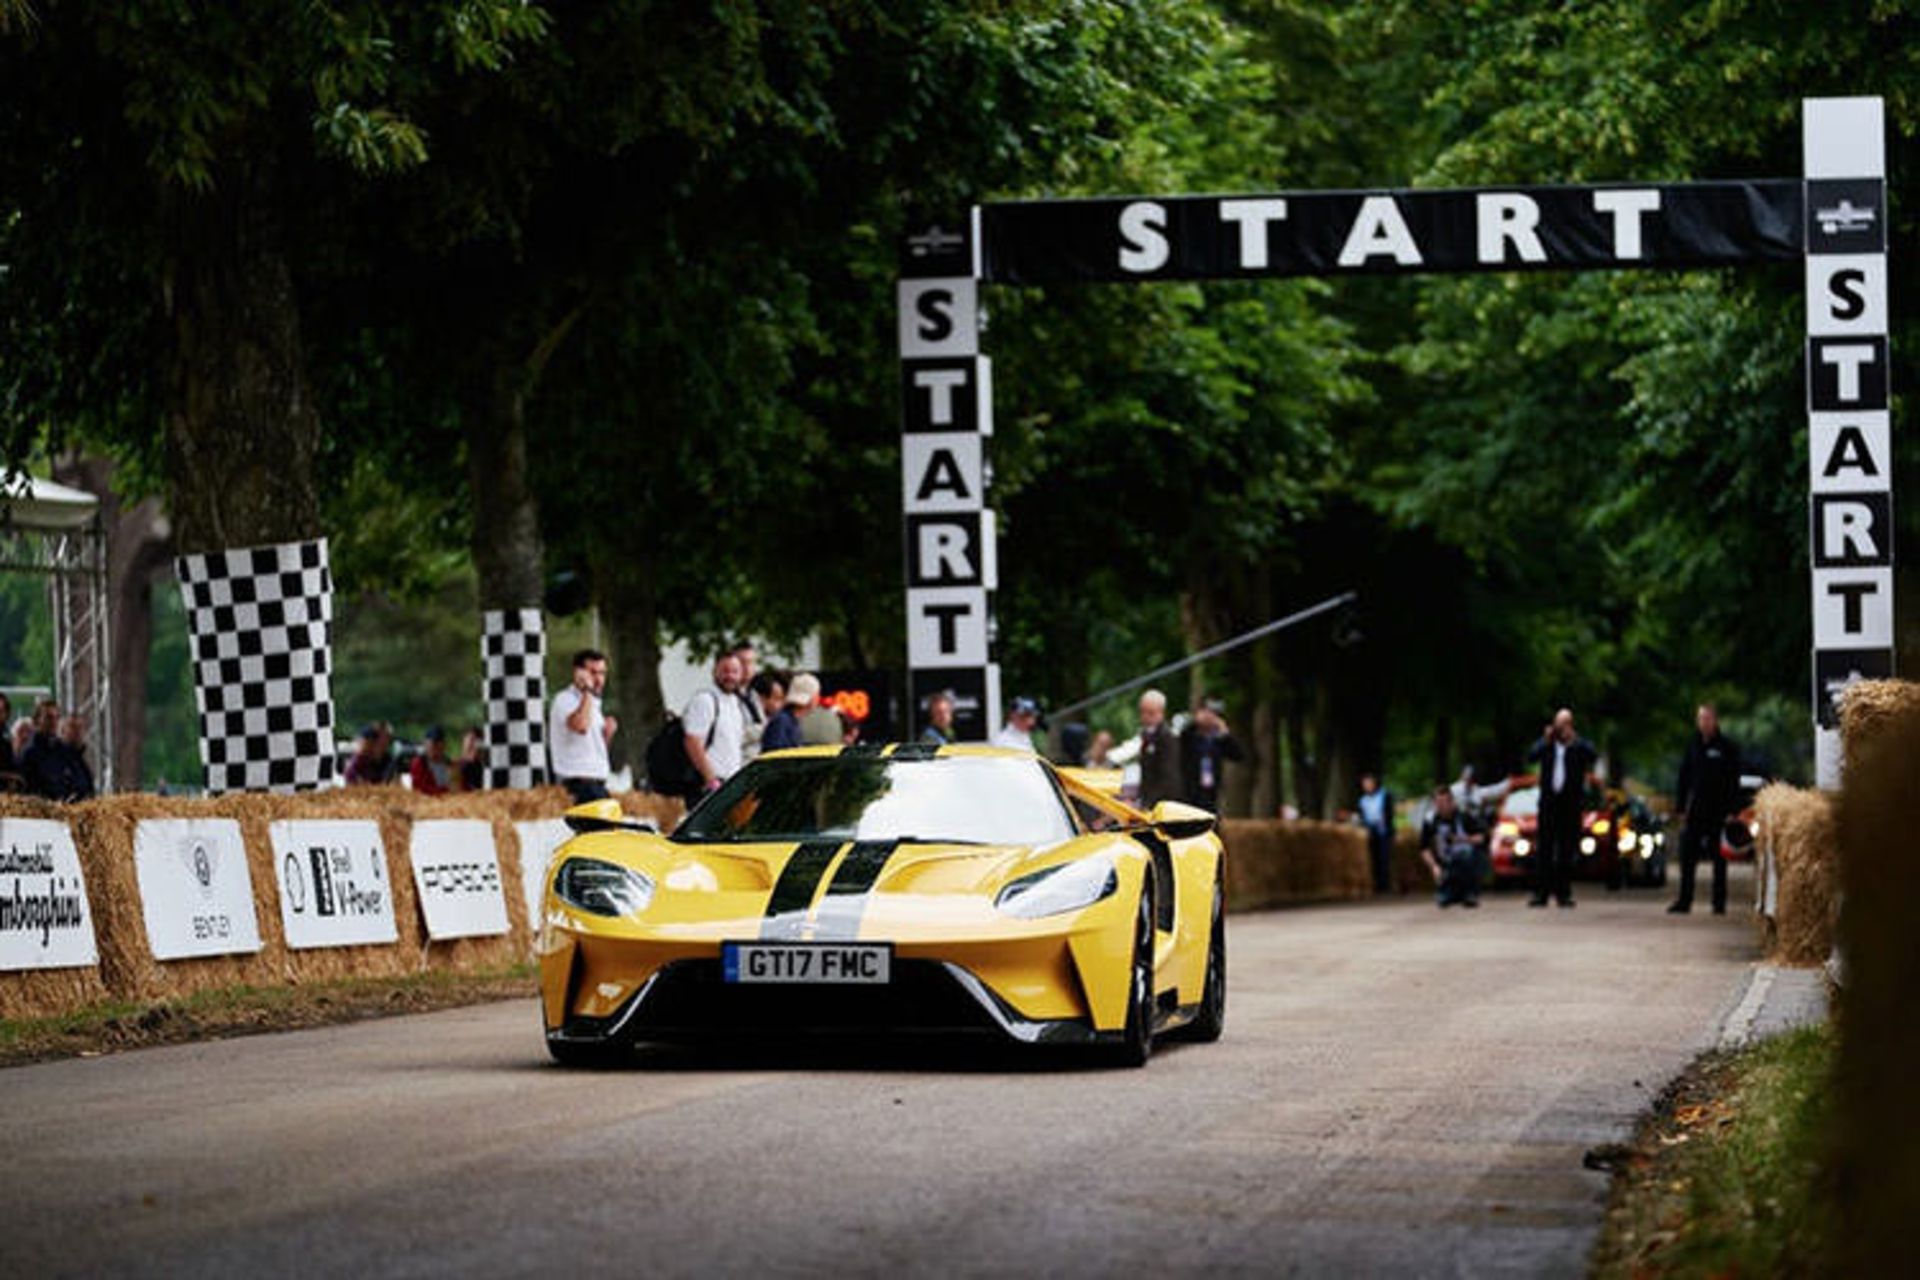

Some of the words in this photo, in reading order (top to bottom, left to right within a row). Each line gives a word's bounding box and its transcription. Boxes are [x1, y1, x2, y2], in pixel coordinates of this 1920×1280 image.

[1118, 189, 1661, 273] START
[913, 288, 975, 655] START
[1820, 268, 1880, 636] START
[750, 951, 813, 977] GT17
[821, 952, 878, 978] FMC
